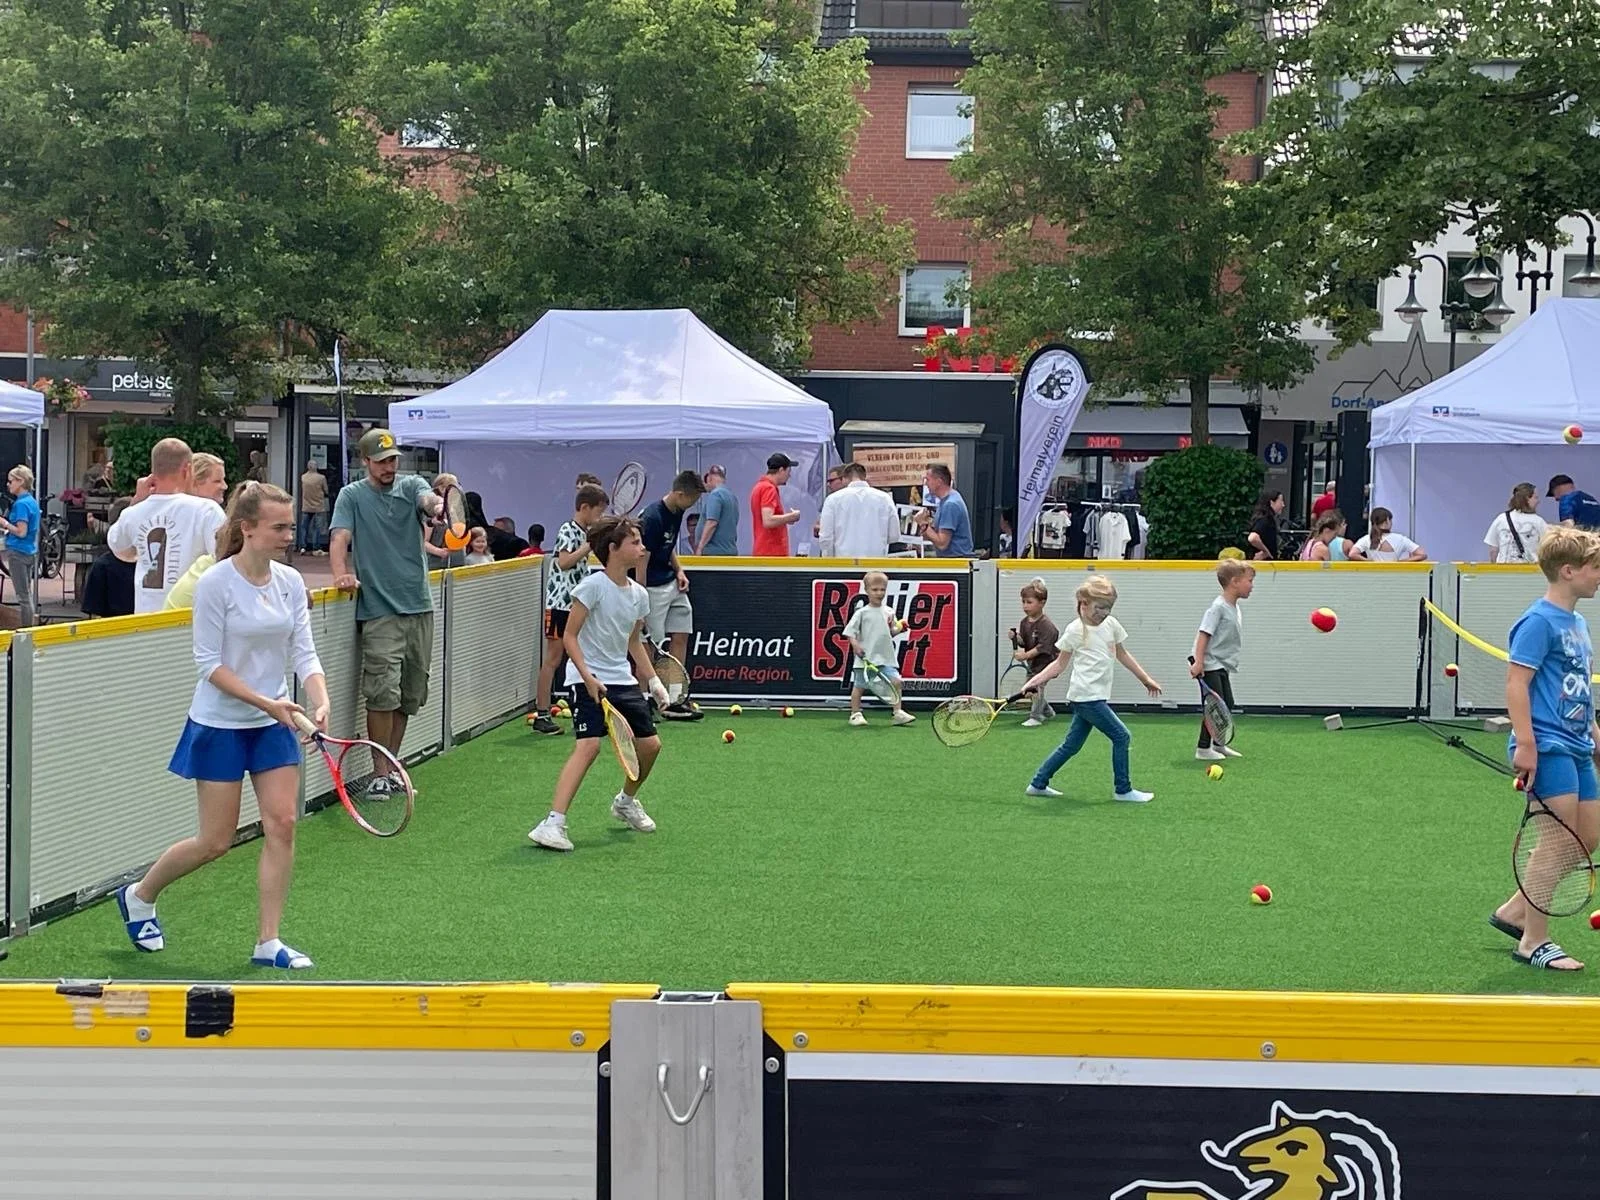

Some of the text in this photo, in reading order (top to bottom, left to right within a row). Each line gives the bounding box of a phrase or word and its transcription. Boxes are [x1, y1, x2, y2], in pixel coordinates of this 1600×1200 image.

[1087, 436, 1121, 448] NKD
[867, 453, 890, 462] VEREIN
[1020, 414, 1064, 502] Heimatverein
[818, 582, 952, 630] Reier
[692, 631, 794, 658] Heimat
[692, 665, 794, 684] Deine Region.
[579, 722, 588, 732] LS
